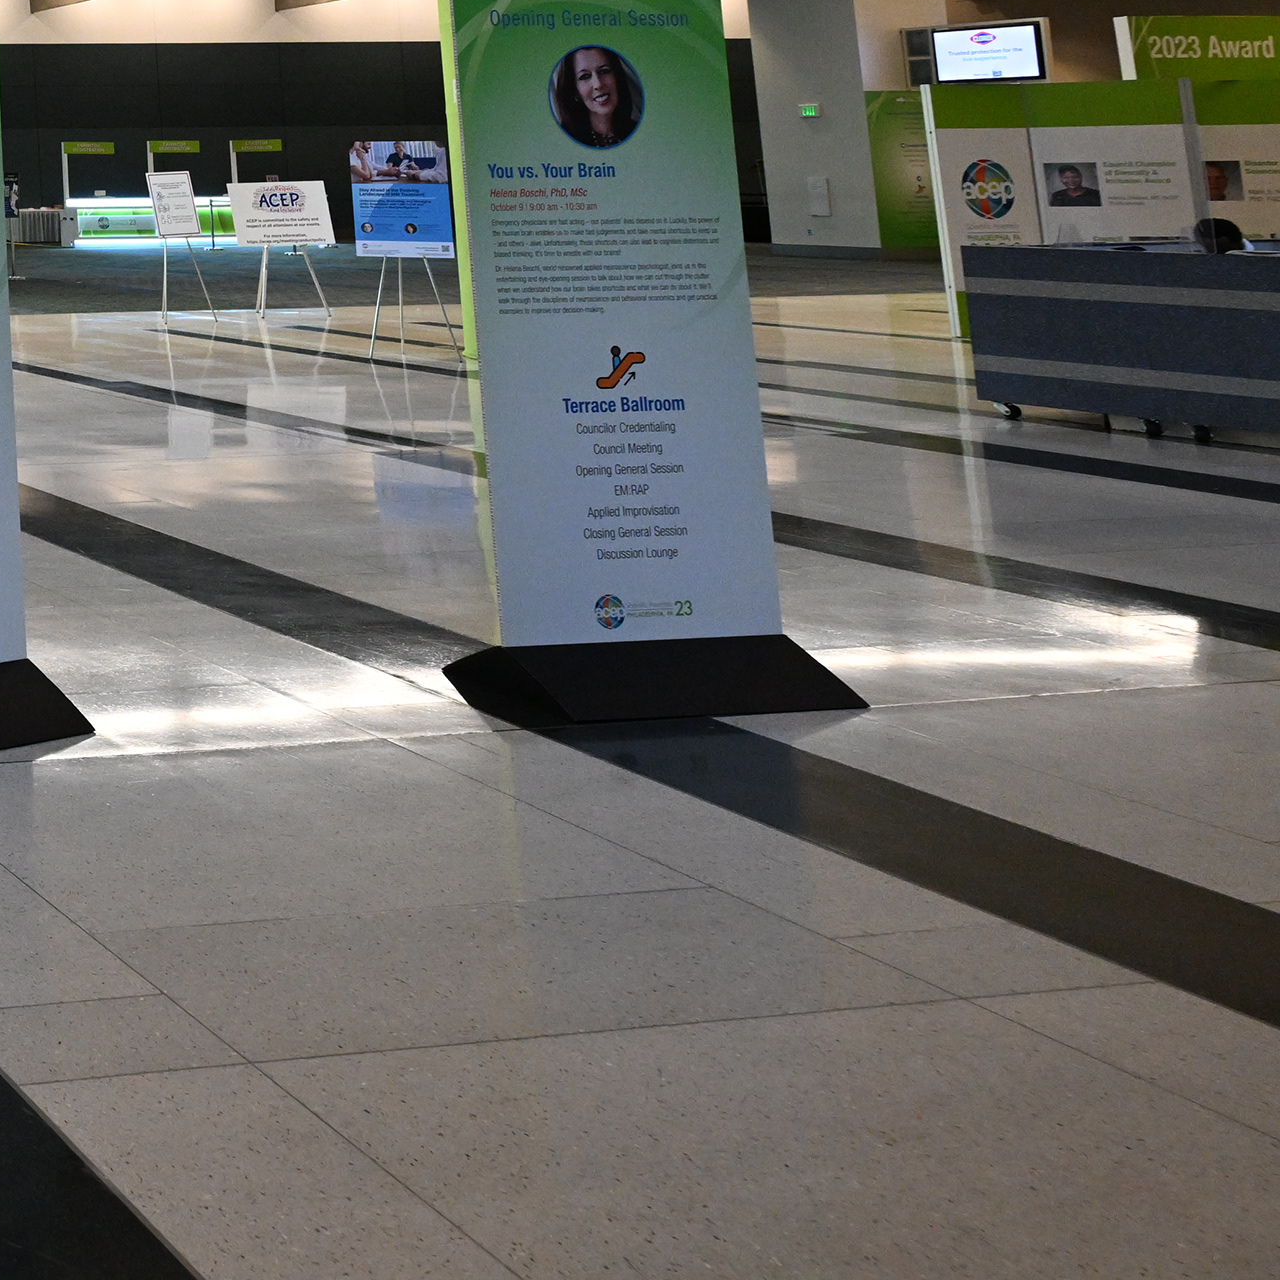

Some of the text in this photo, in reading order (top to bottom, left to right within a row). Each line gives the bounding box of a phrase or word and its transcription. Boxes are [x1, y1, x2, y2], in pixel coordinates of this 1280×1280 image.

[490, 10, 688, 30] Opening General Session
[1149, 35, 1276, 60] 2023 Award
[488, 162, 616, 179] You vs. Your Brain
[490, 189, 517, 198] Helena
[551, 189, 568, 197] PhD,
[570, 188, 587, 196] MSc
[962, 180, 1015, 204] acep
[260, 193, 299, 208] ACEP
[562, 396, 685, 413] Terrace Ballroom
[576, 422, 676, 434] Councilor Credentialing
[594, 443, 663, 455] Council Meeting
[576, 463, 684, 477] Opening General Session
[674, 600, 693, 616] 23
